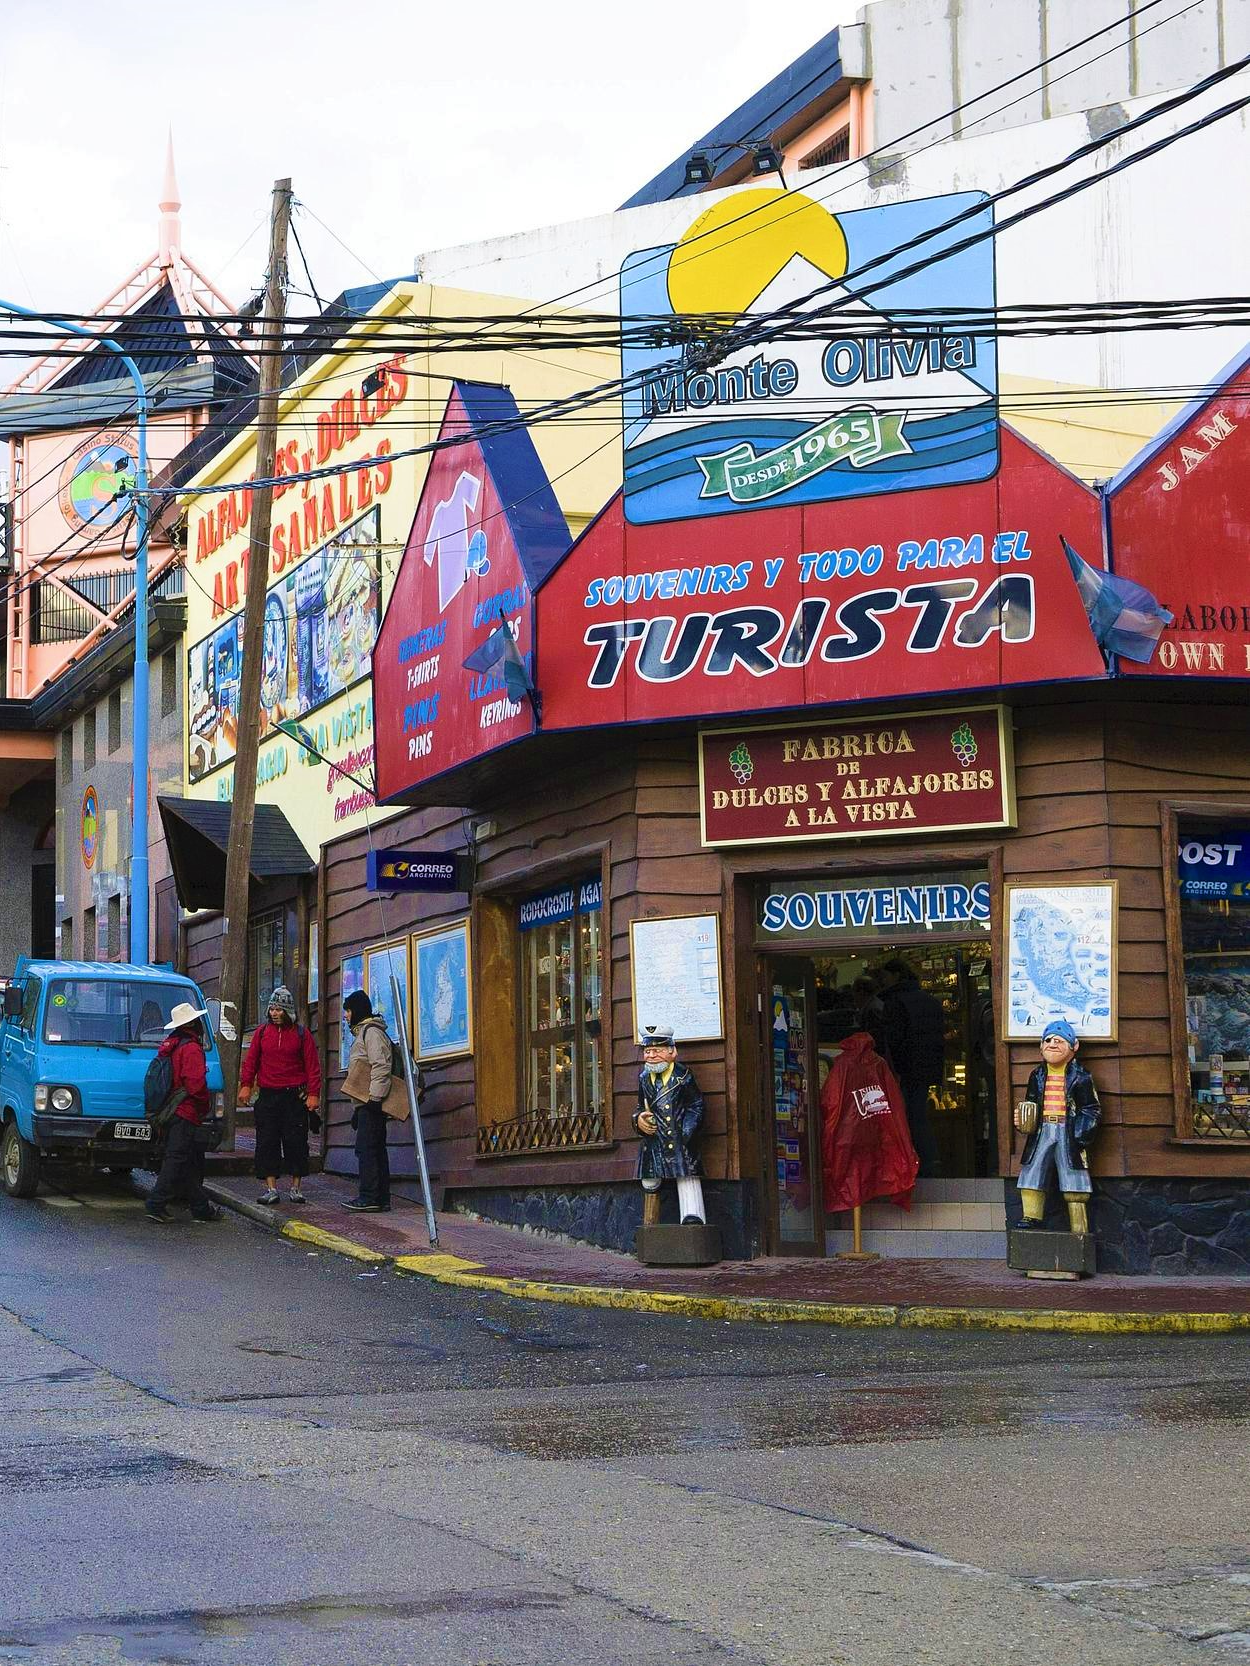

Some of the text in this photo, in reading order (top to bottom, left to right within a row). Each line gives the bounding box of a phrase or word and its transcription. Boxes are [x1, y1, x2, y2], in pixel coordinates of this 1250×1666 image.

[643, 328, 977, 415] Monte Olivia
[732, 418, 871, 488] DESDE 1965
[1157, 410, 1238, 491] JAM
[211, 437, 392, 620] ARTSANALES
[584, 530, 1032, 608] SOUVENIRS Y TODO PARA EL
[583, 572, 1036, 690] TURISTA
[407, 654, 440, 691] T-SHIRTS
[1158, 641, 1225, 671] OWN
[403, 691, 440, 733] PINS
[408, 730, 433, 761] PINS
[782, 729, 916, 763] FABRICA
[836, 761, 860, 776] DE
[712, 769, 995, 810] DULCES Y ALFAJORES
[784, 800, 917, 827] A LA VISTA
[410, 864, 454, 873] CORREO
[1185, 881, 1228, 890] CORREO
[520, 889, 574, 924] RODOCROSITA
[761, 882, 991, 932] SOUVENIRS
